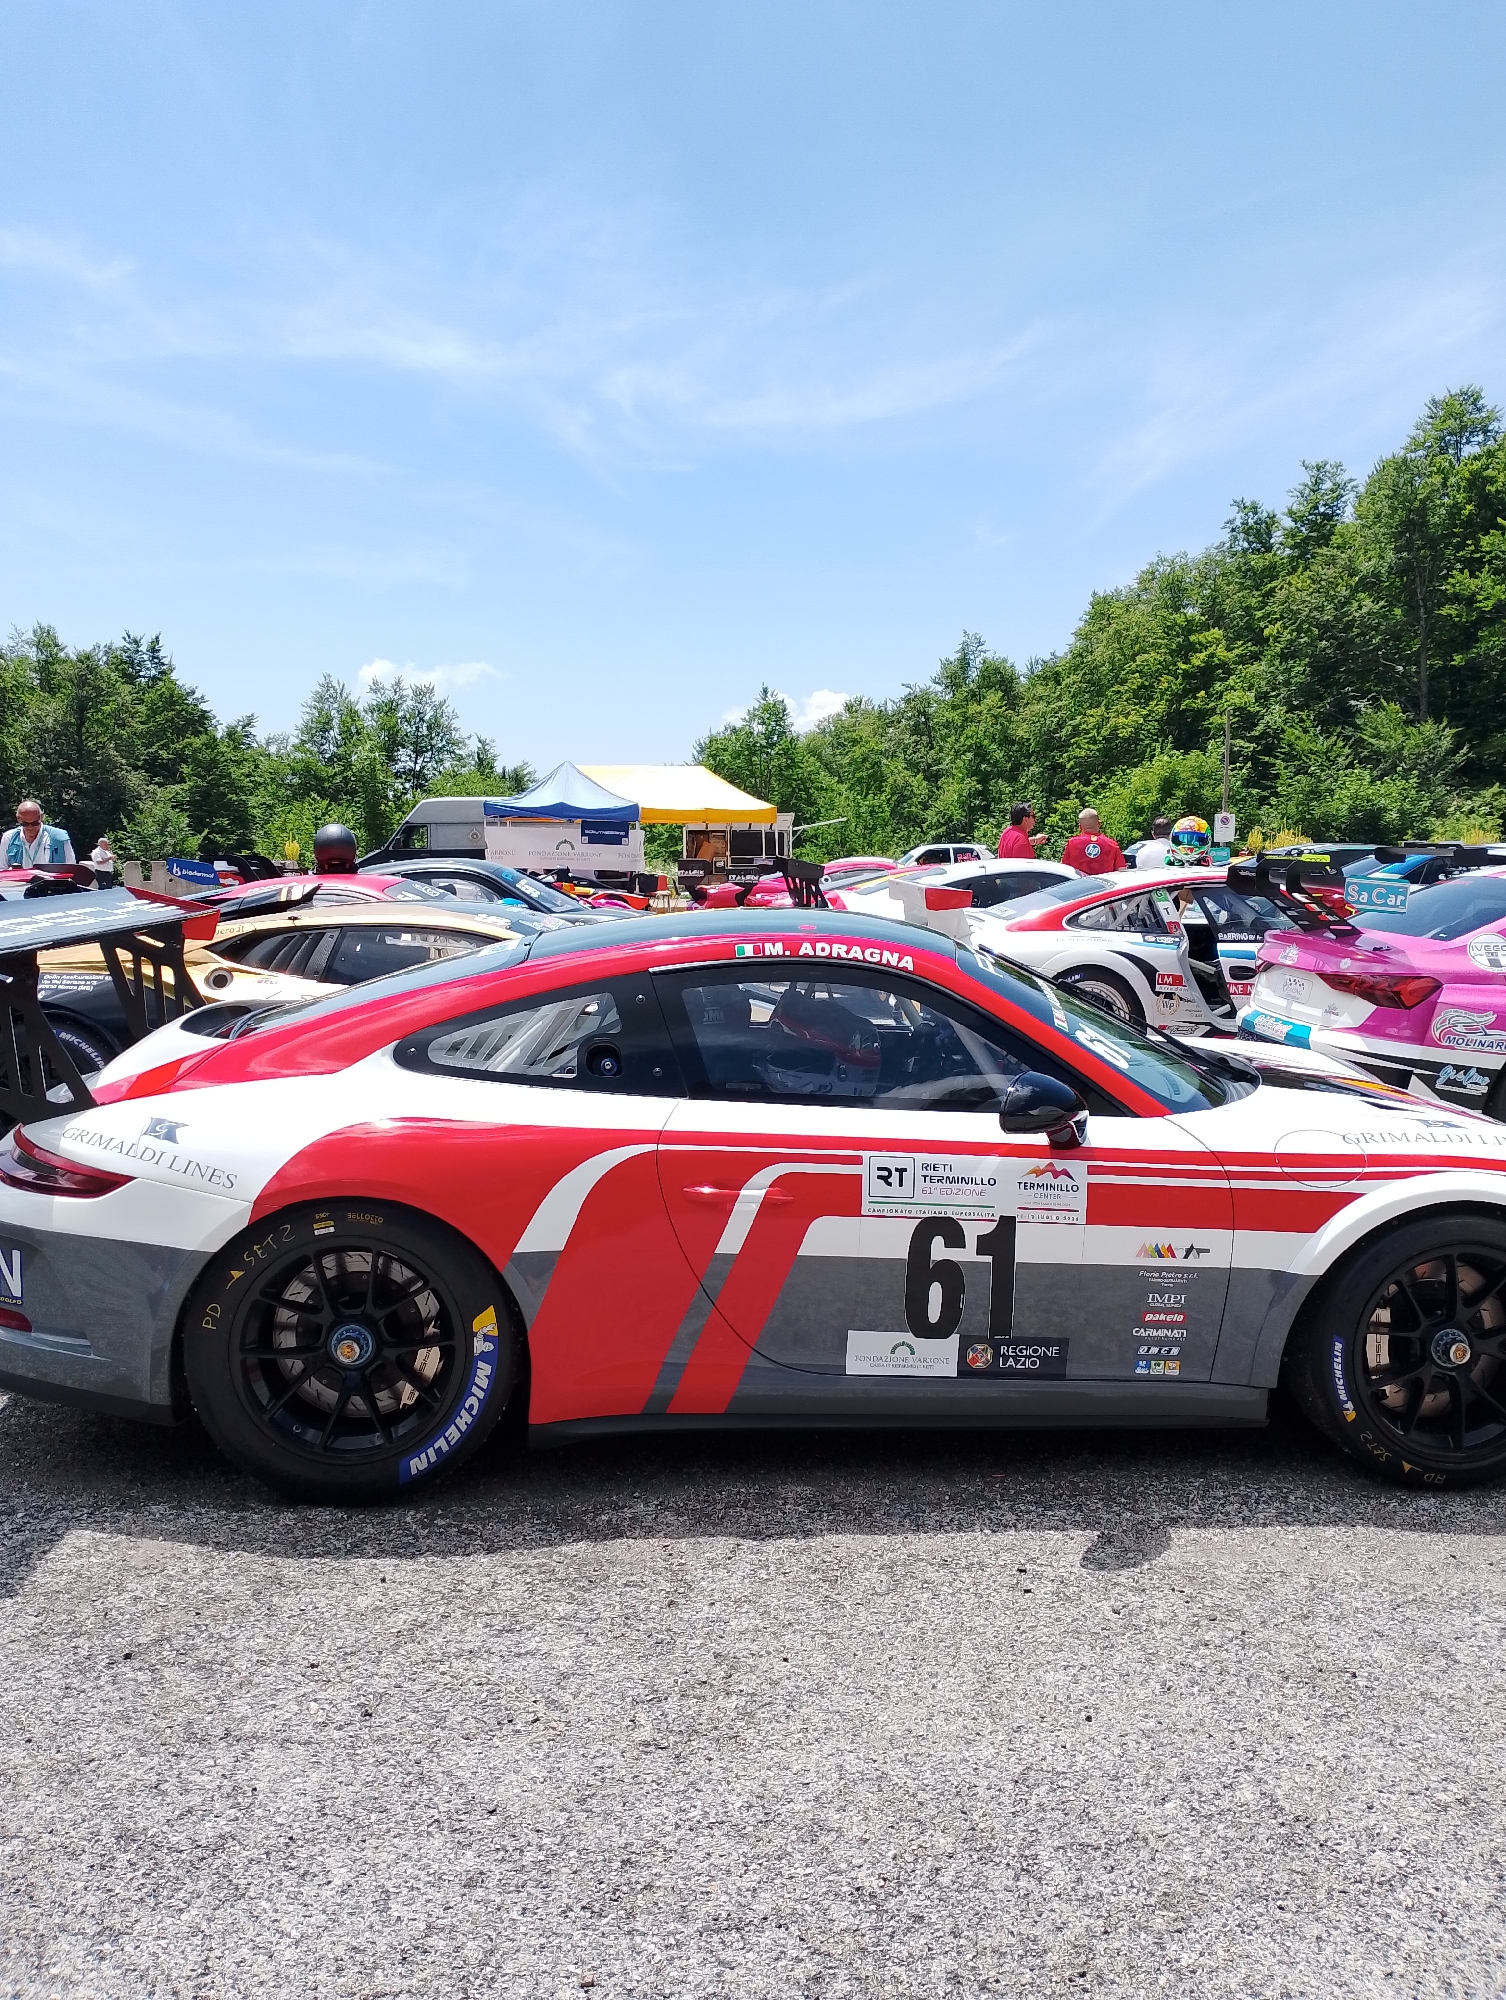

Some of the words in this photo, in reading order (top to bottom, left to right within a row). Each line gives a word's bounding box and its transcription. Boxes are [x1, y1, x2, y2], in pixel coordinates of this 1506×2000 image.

[1087, 846, 1099, 858] hp
[765, 942, 790, 956] M.
[799, 942, 914, 972] ADRAGNA
[1445, 1035, 1506, 1051] MOLINAR
[1342, 1132, 1472, 1145] GRIMALDI
[62, 1127, 167, 1165] GRIMALDI
[167, 1154, 238, 1189] LINES
[921, 1162, 953, 1174] RIETI
[876, 1166, 908, 1188] RT
[920, 1174, 997, 1187] TERMINILLO
[939, 1188, 987, 1197] EDIZIONE
[1017, 1181, 1080, 1193] TERMINILLO
[904, 1214, 1017, 1339] 61
[1160, 1271, 1182, 1279] Pietro
[1147, 1293, 1187, 1304] IMPI
[1144, 1312, 1185, 1322] pakelo
[1132, 1328, 1187, 1338] CARMINATI
[1000, 1345, 1060, 1357] REGIONE
[854, 1355, 910, 1363] FONDAZIONE
[911, 1356, 950, 1365] VARRONE
[999, 1357, 1040, 1369] LAZIO
[1333, 1341, 1347, 1401] MICHELIN
[409, 1360, 493, 1476] MICHELIN
